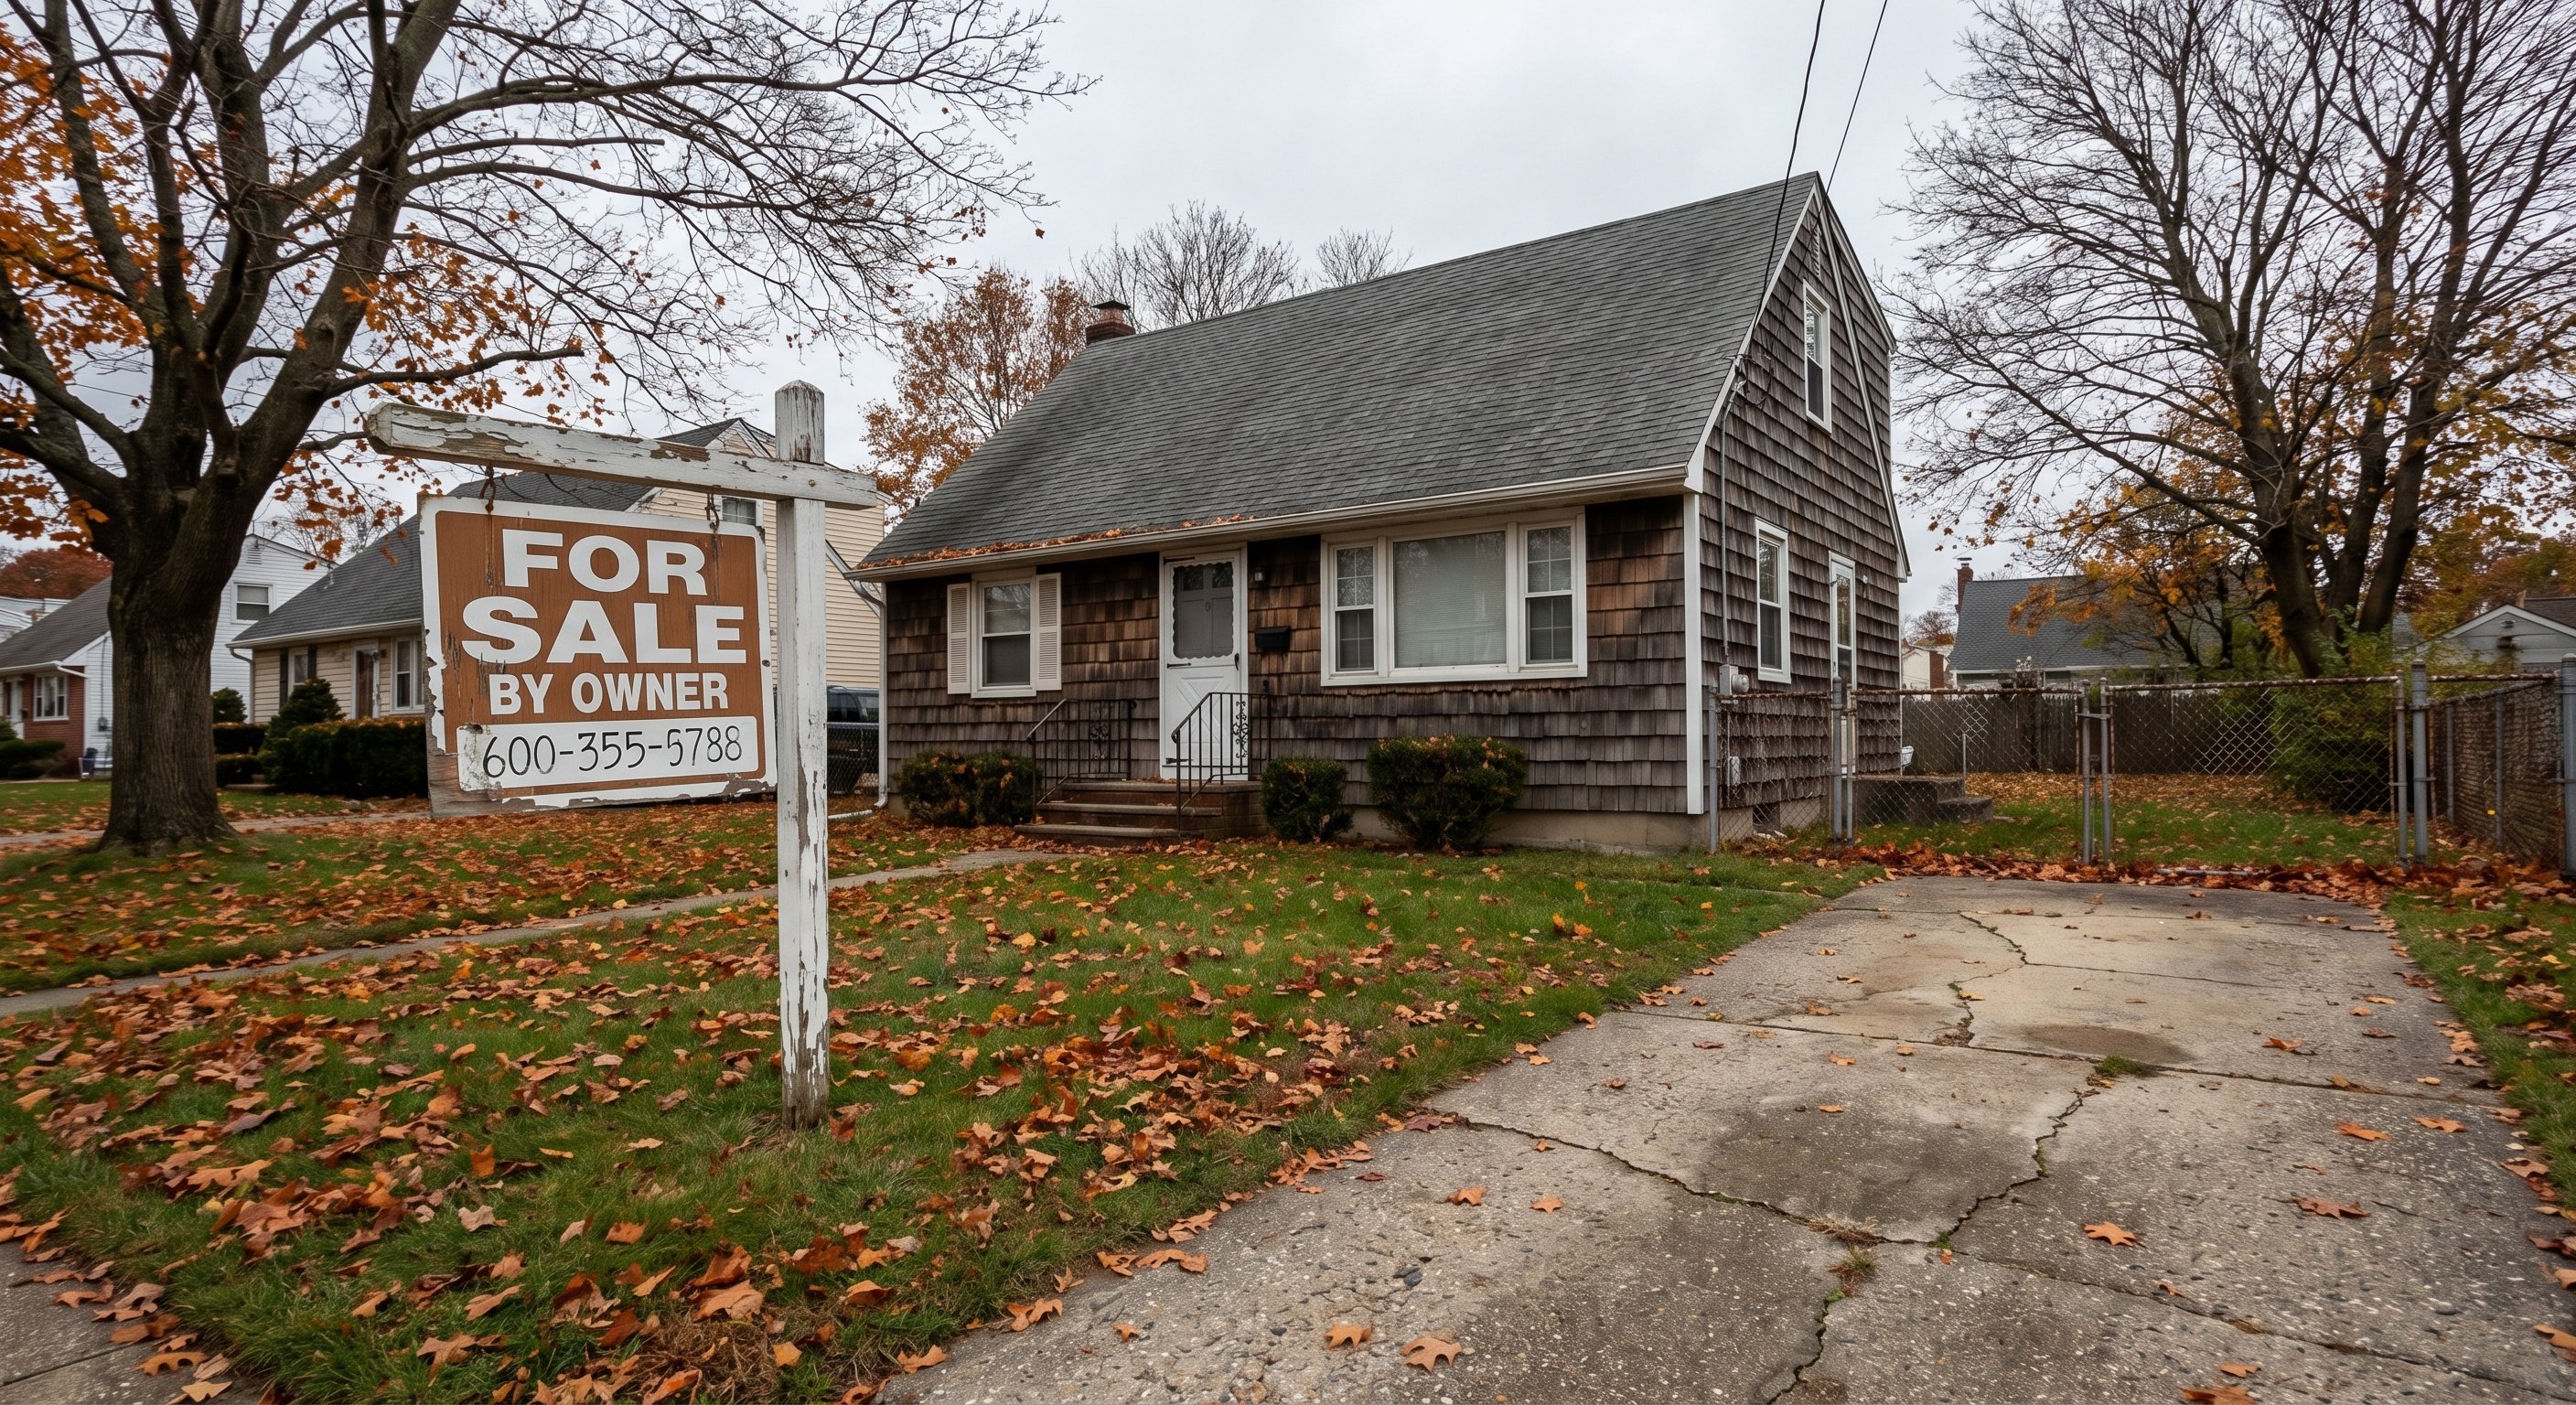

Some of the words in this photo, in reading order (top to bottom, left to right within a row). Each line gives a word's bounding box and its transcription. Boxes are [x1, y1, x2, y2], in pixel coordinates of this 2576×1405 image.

[502, 529, 708, 595] FOR
[461, 596, 746, 664] SALE
[488, 673, 553, 715] BY
[571, 672, 728, 713] OWNER
[482, 725, 743, 778] 600-355-5788
